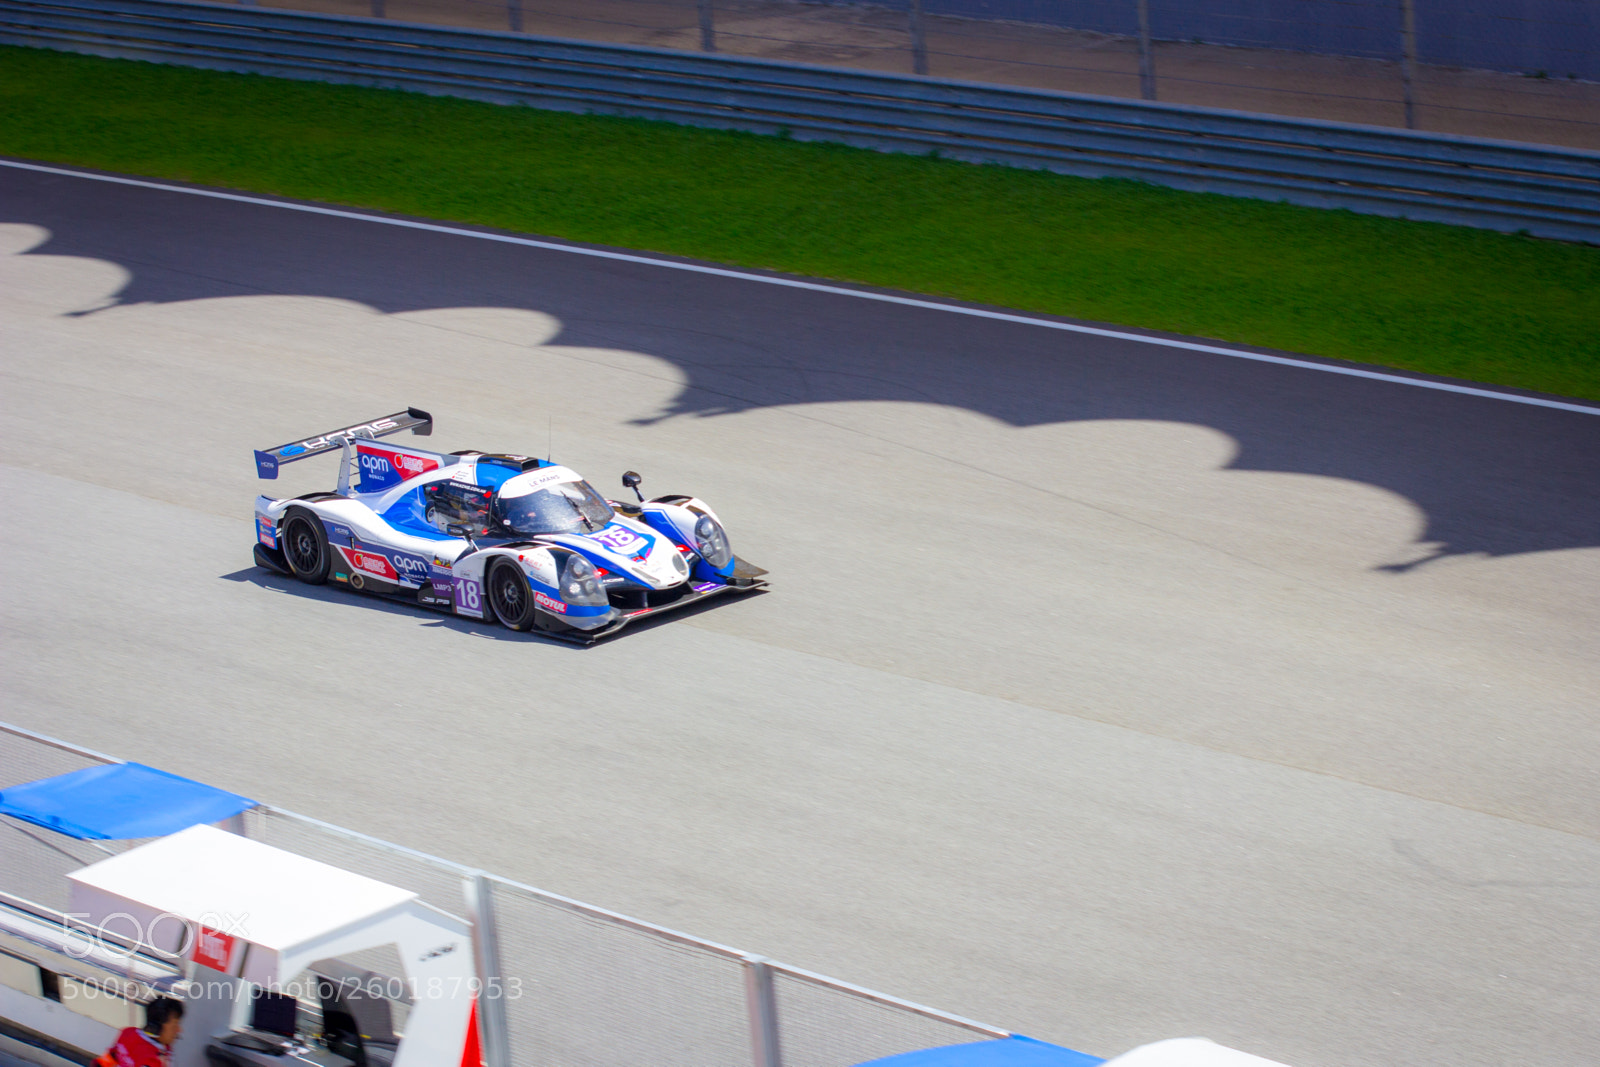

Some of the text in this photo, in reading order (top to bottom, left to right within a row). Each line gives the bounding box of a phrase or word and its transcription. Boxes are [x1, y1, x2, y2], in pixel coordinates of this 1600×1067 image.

[362, 454, 389, 474] apm
[598, 529, 635, 548] 18
[394, 555, 428, 573] apm
[456, 579, 479, 609] 18
[535, 593, 566, 613] MOTUL
